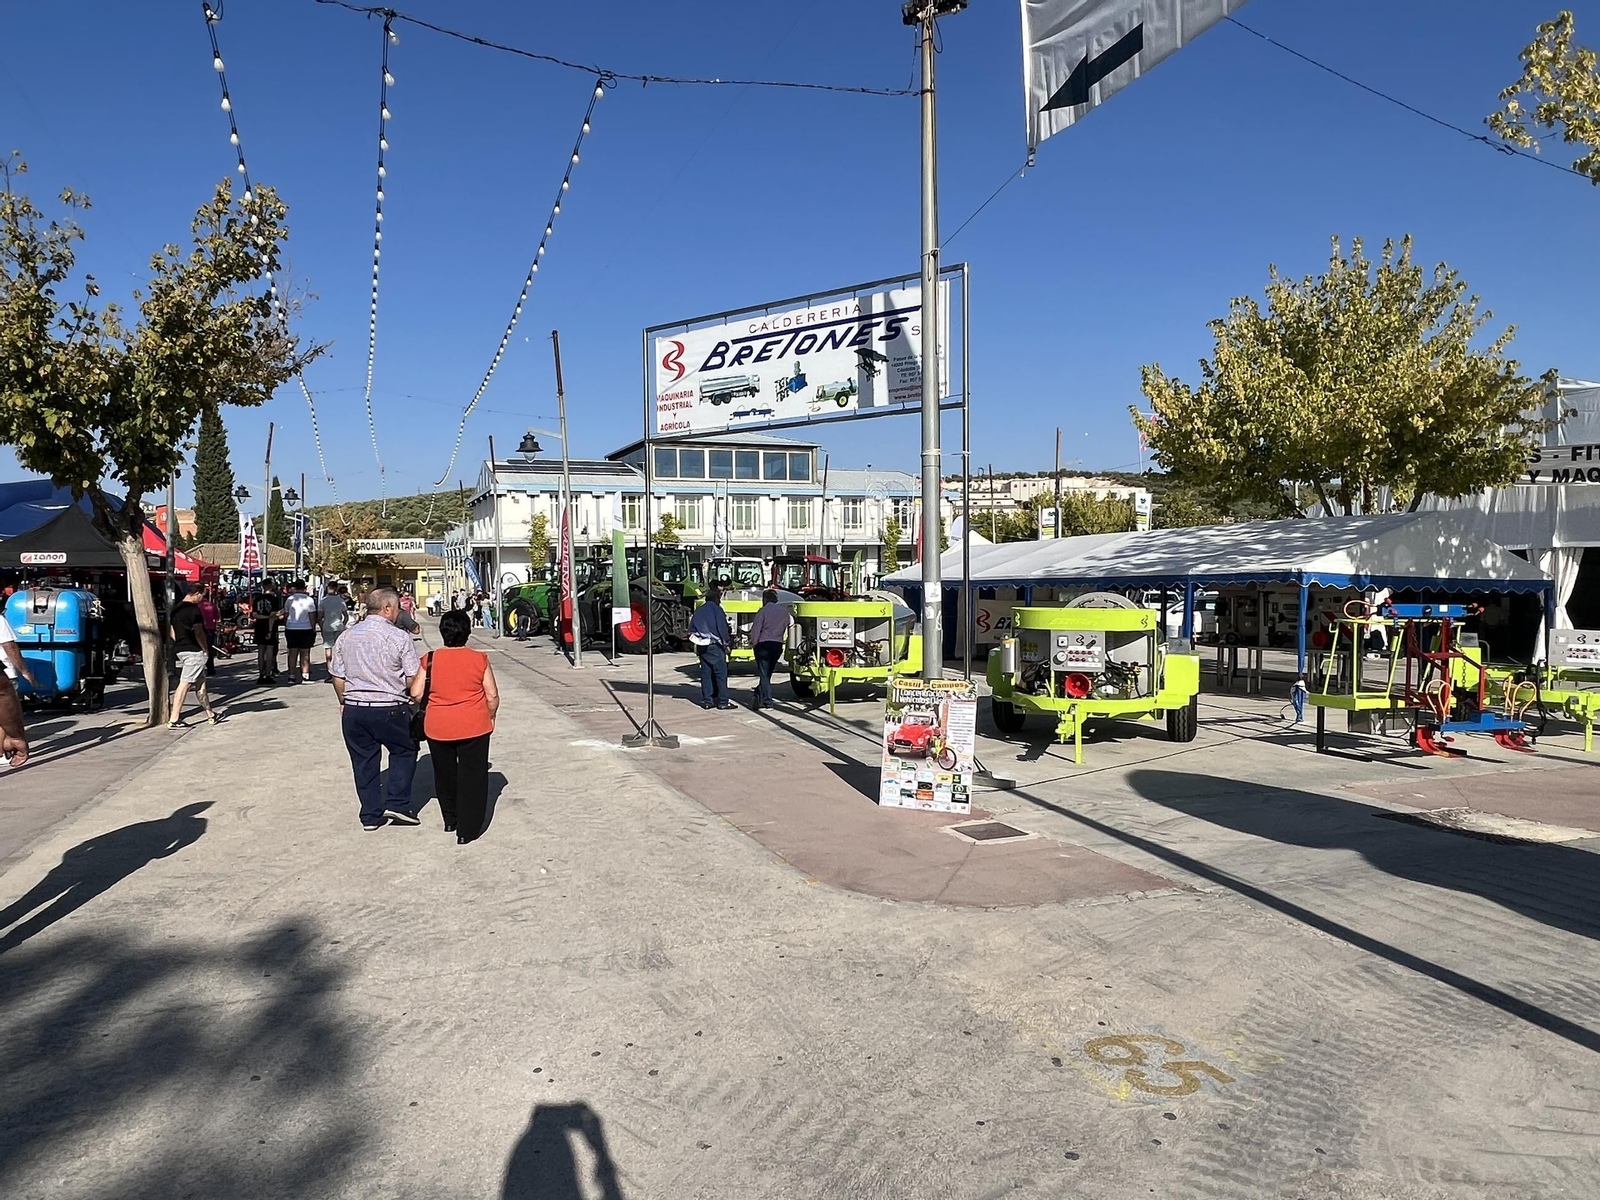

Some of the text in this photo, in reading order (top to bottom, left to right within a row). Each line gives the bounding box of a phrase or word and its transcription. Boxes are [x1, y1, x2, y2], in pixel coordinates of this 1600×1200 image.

[749, 304, 862, 333] CALDERERIA
[698, 308, 914, 372] BRETONES
[355, 541, 423, 551] GROALIMENTARIA
